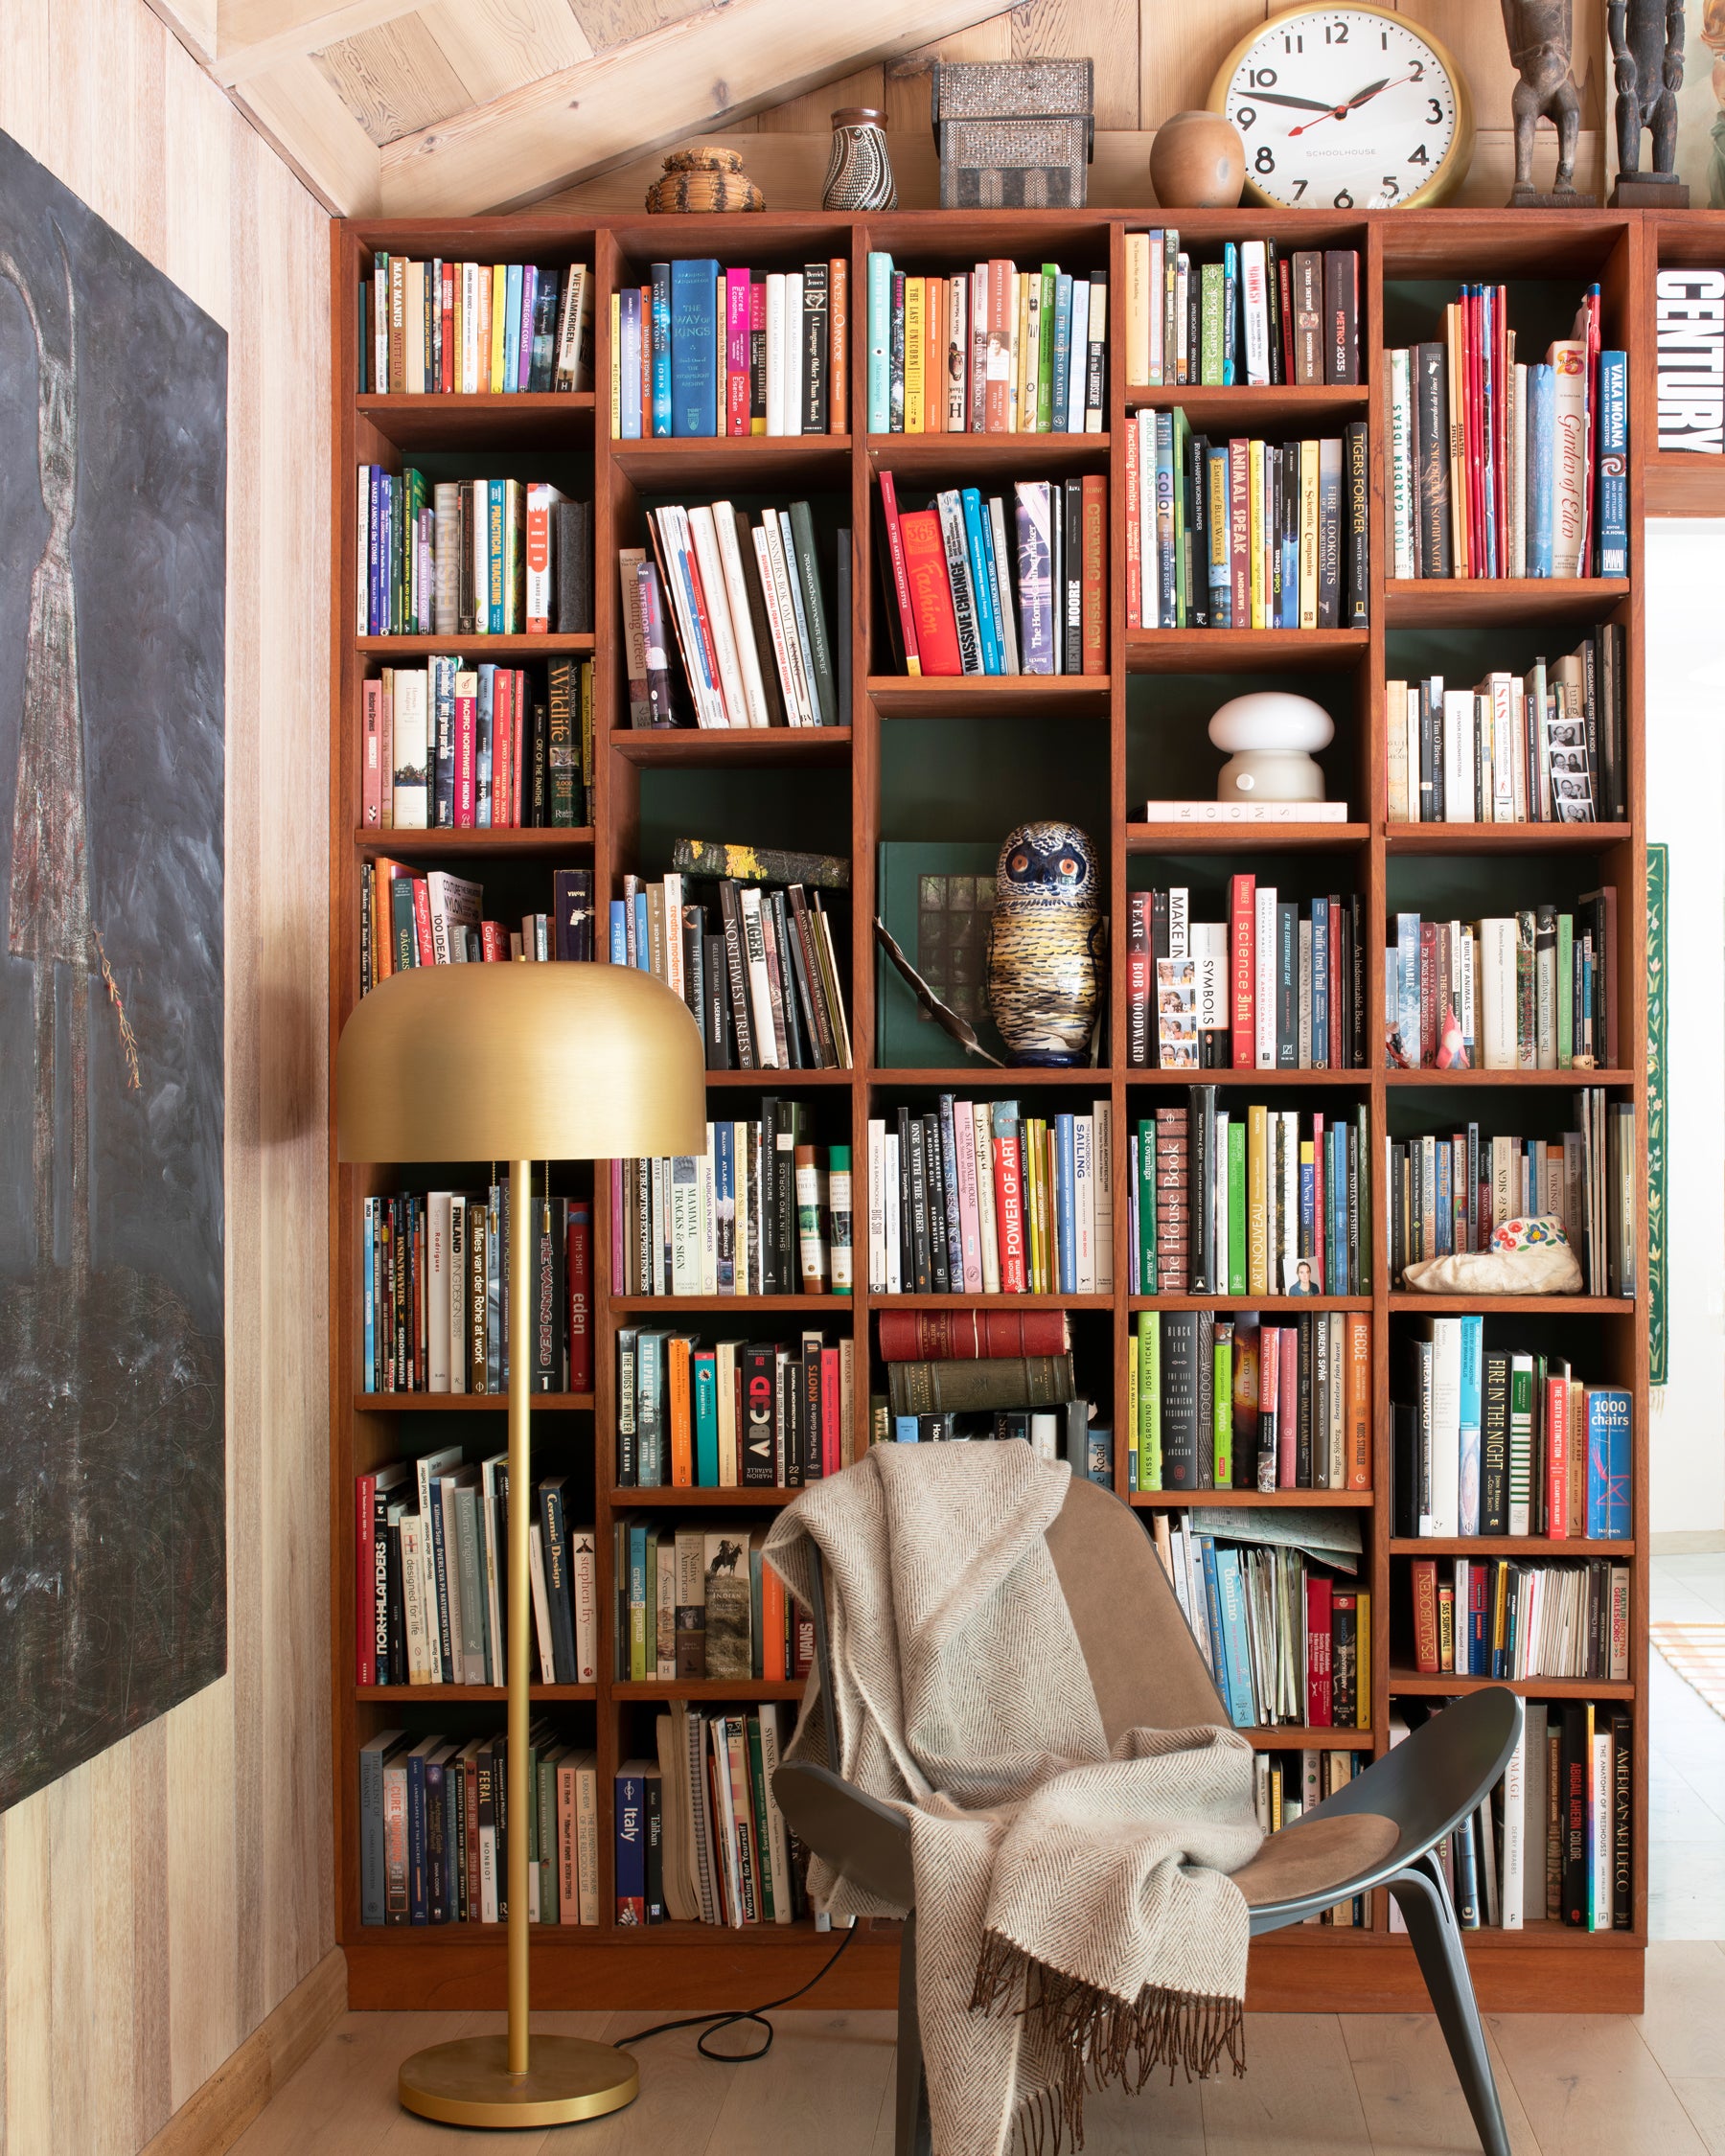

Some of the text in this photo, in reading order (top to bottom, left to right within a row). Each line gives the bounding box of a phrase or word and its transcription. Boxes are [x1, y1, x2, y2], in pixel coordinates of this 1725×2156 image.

[1285, 35, 1302, 54] 11
[1326, 22, 1348, 44] 12
[1382, 33, 1388, 50] 1
[1250, 69, 1277, 87] 10
[1408, 60, 1424, 81] 2
[1236, 106, 1256, 131] 9
[1425, 99, 1443, 125] 3
[1254, 147, 1276, 174] 8
[1305, 149, 1377, 157] SCHOOLHOUSE
[1407, 144, 1429, 166] 4
[1292, 179, 1308, 200] 7
[1333, 188, 1354, 210] 6
[1380, 176, 1399, 199] 5
[393, 262, 402, 328] MAX MANUS
[565, 273, 583, 343] VIETNAMKRIGEN
[810, 324, 819, 356] Language
[908, 330, 917, 366] UNICORN
[1336, 311, 1346, 371] METRO 2035
[811, 358, 820, 378] Older
[811, 380, 819, 398] Than
[811, 401, 819, 422] Words
[1611, 365, 1622, 438] VAKA MOANA
[1126, 424, 1137, 469] Practicing
[1158, 470, 1172, 519] color
[1232, 444, 1246, 554] ANIMAL SPEAK
[1353, 433, 1365, 534] TIGERS FOREVER
[1392, 405, 1403, 550] 1000 GARDEN IDEAS
[1559, 414, 1581, 539] Garden of Eden
[491, 505, 502, 606] PRACTICAL TRACKING
[910, 560, 944, 637] Fashion
[951, 562, 979, 673] MASSIVE CHANGE
[628, 580, 645, 671] Building Green
[550, 665, 569, 743] Wildlife
[535, 754, 542, 763] OF
[1434, 737, 1442, 765] O'Brien
[418, 889, 432, 954] tomboy style
[434, 914, 444, 932] 100
[745, 911, 766, 963] TIGER!
[1132, 899, 1144, 938] FEAR
[1171, 896, 1184, 939] MAKE
[724, 919, 750, 1052] NORTHWEST TREES
[1237, 922, 1253, 1021] science Ink
[1464, 962, 1471, 974] BY
[1132, 961, 1144, 1063] BOB WOODWARD
[1203, 959, 1214, 1024] SYMBOLS
[911, 1123, 920, 1144] ONE
[1076, 1123, 1085, 1179] SAILING
[912, 1147, 921, 1175] WITH
[675, 1188, 685, 1230] TRACKS
[688, 1188, 698, 1238] MAMMAL
[1001, 1137, 1019, 1255] POWER OF ART
[1550, 1173, 1558, 1211] VIKINGS
[452, 1206, 462, 1253] FINLAND
[915, 1203, 925, 1232] TIGER
[1162, 1143, 1181, 1289] The House Book
[675, 1245, 685, 1270] SIGN
[1250, 1204, 1263, 1289] ART NOUVEAU
[473, 1227, 485, 1365] Mies van der Rohe at work
[573, 1293, 587, 1335] eden
[1317, 1321, 1328, 1382] DJURENS SPÅR
[1354, 1325, 1368, 1361] RECCE
[623, 1354, 633, 1433] THE DOGS OF WINTER
[808, 1365, 817, 1402] KNOTS
[1201, 1361, 1211, 1427] WOODCUT
[1486, 1359, 1506, 1471] FIRE IN THE NIGHT
[1592, 1414, 1630, 1427] chairs
[1595, 1400, 1627, 1413] 1000
[1553, 1420, 1562, 1458] EXTINCTION
[461, 1495, 474, 1578] Modern Originals
[405, 1558, 422, 1636] designed for life
[578, 1556, 594, 1625] stephen fry
[1226, 1567, 1239, 1622] domino
[1417, 1573, 1434, 1660] PSALMBOKEN
[479, 1770, 491, 1804] FERAL
[621, 1807, 638, 1843] Italy
[1570, 1762, 1581, 1862] ABIGAIL AHERN COLOR.
[1617, 1746, 1630, 1892] AMERICAN ART DECO
